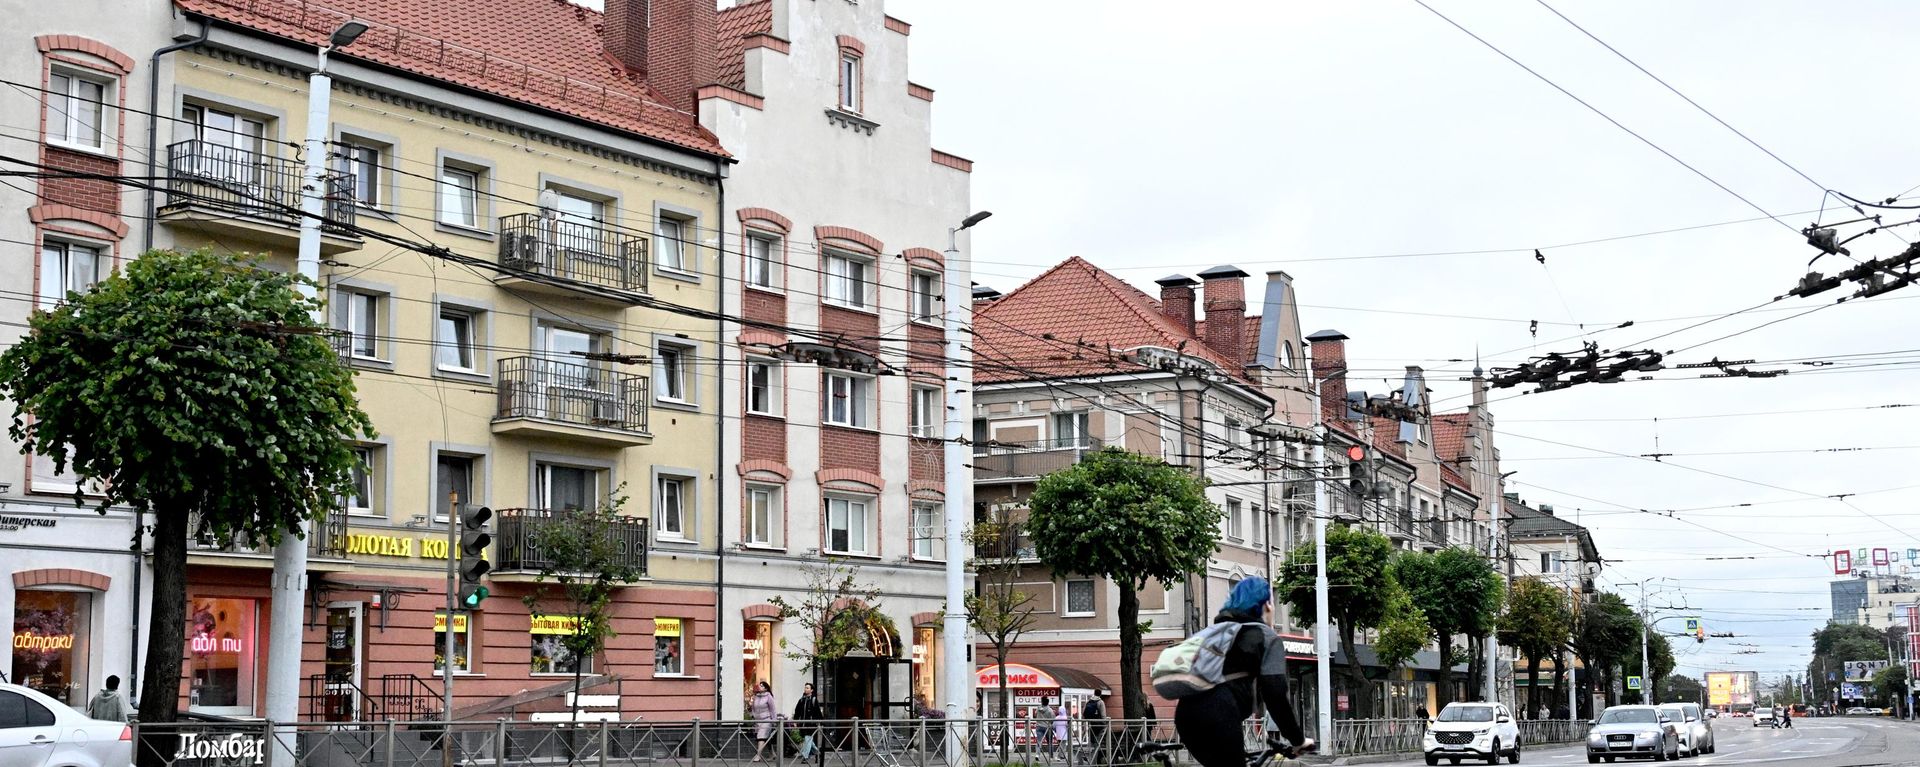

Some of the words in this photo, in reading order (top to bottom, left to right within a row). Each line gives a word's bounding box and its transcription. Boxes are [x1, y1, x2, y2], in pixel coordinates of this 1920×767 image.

[0, 515, 56, 529] итерская
[336, 534, 412, 557] ОЛОТАЯ
[980, 674, 1037, 684] опика
